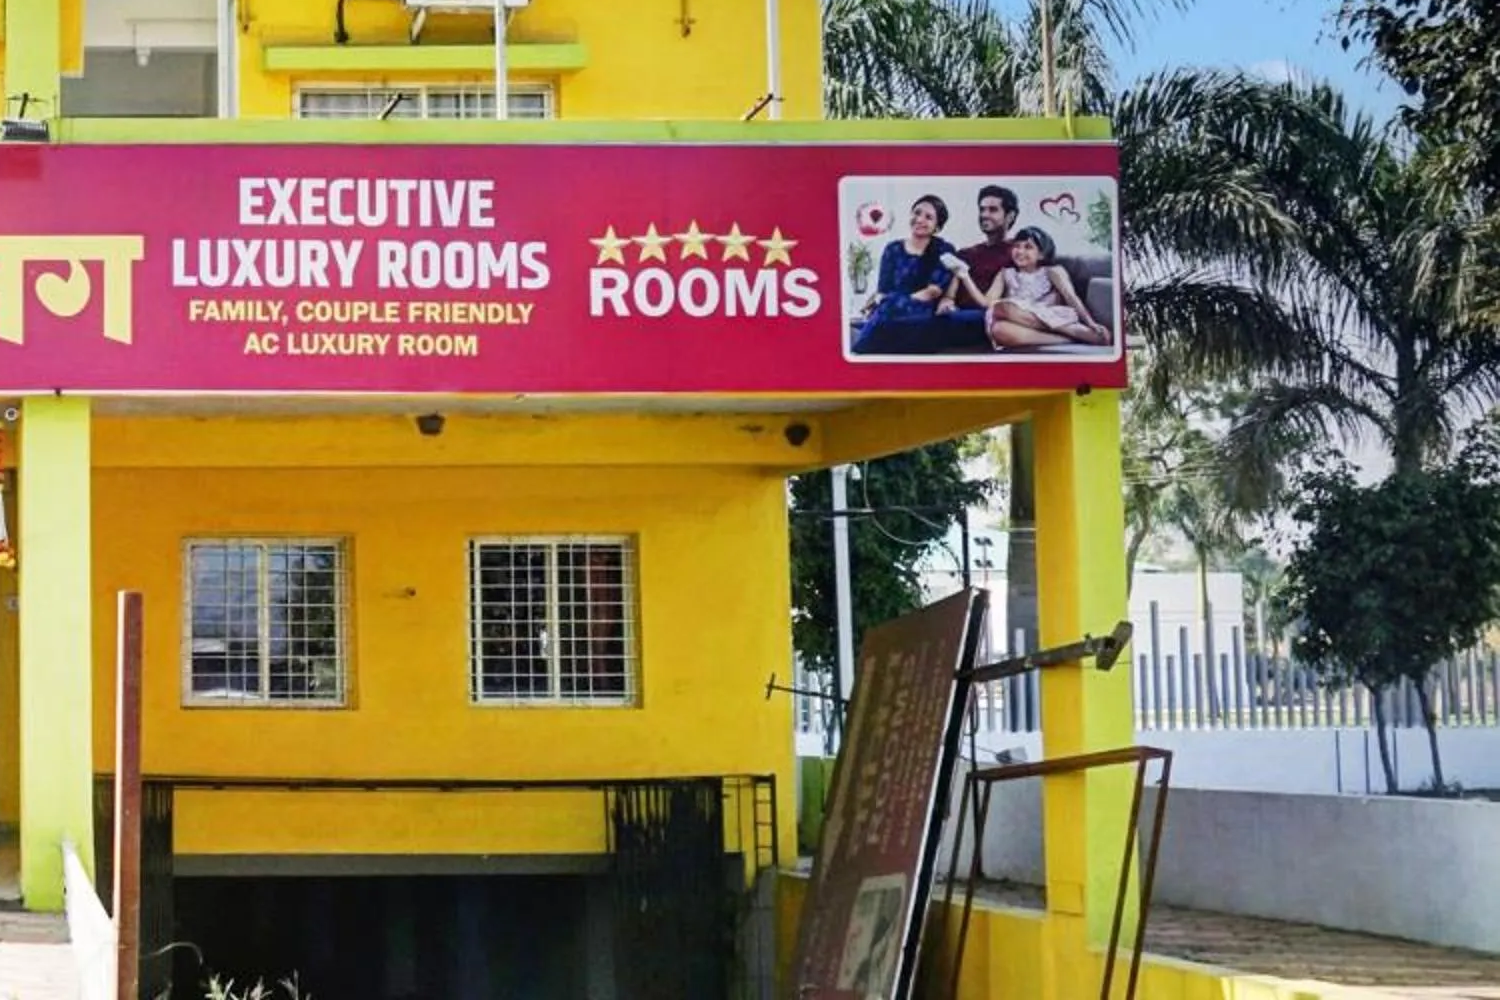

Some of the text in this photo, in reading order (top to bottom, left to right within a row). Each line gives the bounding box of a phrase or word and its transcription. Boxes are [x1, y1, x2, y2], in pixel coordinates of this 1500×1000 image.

[239, 177, 495, 227] EXECUTIVE
[172, 239, 550, 290] LUXURY ROOMS
[189, 300, 534, 326] FAMILY, COUPLE FRIENDLY
[589, 267, 821, 318] ROOMS
[244, 333, 477, 356] AC LUXURY ROOM
